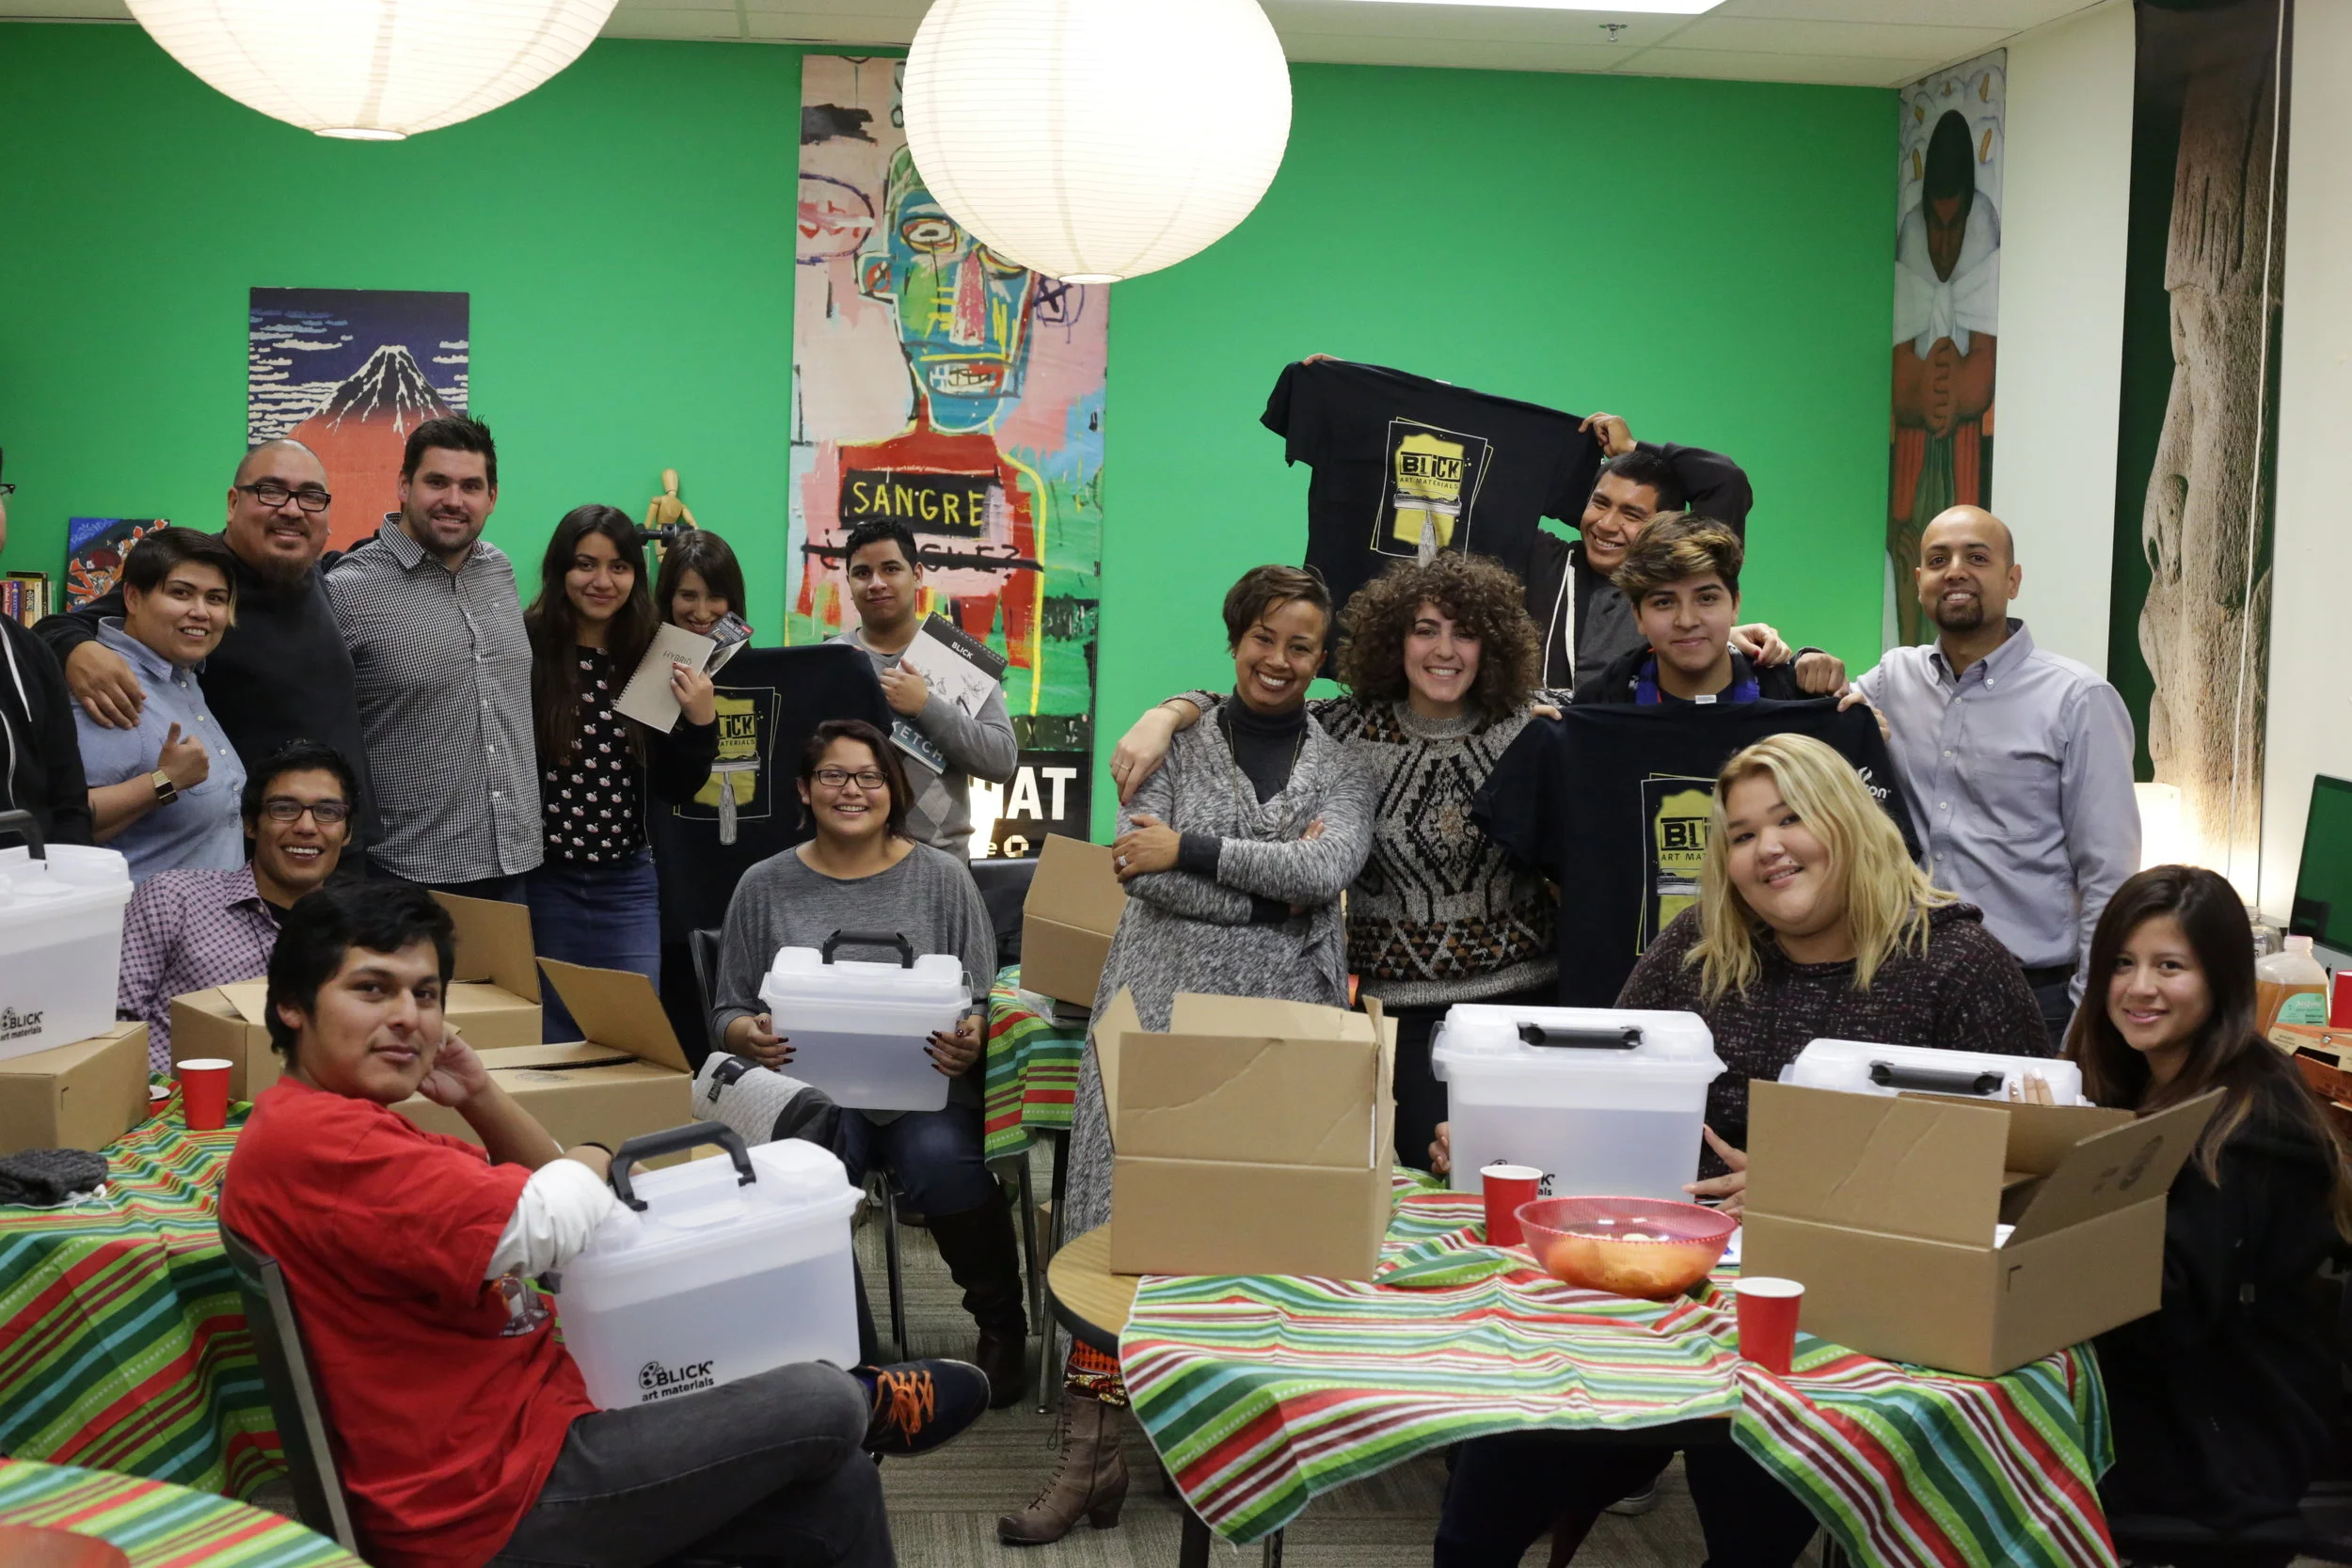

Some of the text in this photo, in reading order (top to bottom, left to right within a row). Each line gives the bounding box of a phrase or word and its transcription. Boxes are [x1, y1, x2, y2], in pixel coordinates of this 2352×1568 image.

[1416, 478, 1460, 490] MATERIALS
[852, 481, 986, 527] SANGRE
[662, 650, 692, 665] HYBRID
[951, 641, 974, 659] BLICK
[720, 738, 755, 748] ATERIALS
[892, 719, 944, 762] KETCH
[1661, 852, 1680, 862] ART
[9, 1011, 43, 1030] BLICK
[10, 1026, 42, 1039] materials
[657, 1360, 713, 1386] BLICK
[642, 1377, 714, 1402] art materials
